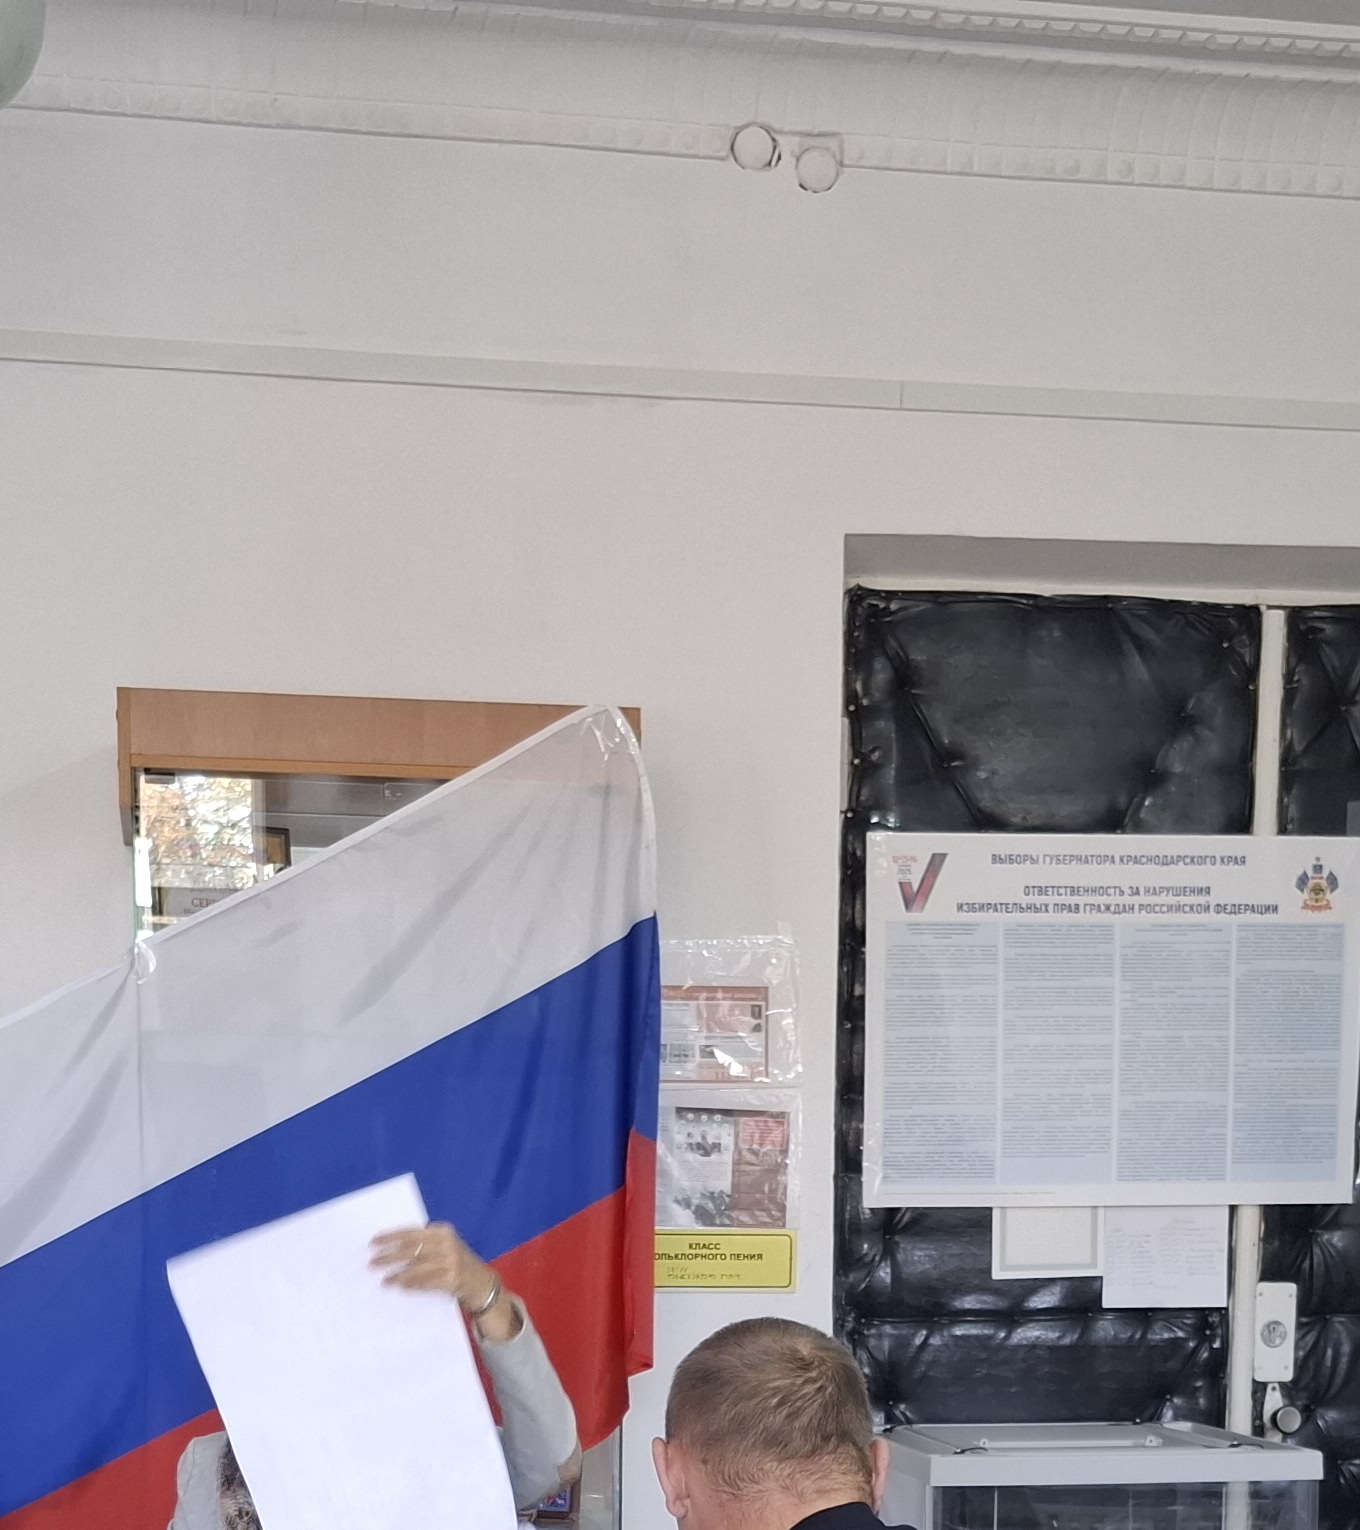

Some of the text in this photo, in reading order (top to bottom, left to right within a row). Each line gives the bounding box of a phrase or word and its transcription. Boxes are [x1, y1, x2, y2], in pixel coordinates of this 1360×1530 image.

[991, 854, 1246, 867] ВЫБОРЫ ГУБЕРНАТОРА КРАСНОДАРСКОГО КРАЯ
[1023, 885, 1212, 897] ОТВЕТСТВЕННОСТЬ ЗА НАРУШЕНИЯ
[956, 901, 1279, 916] ИЗБИРАТЕЛЬНЫХ ПРАВ ГРАЖДАН РОССИЙСКОЙ ФЕДЕРАЦИИ
[688, 1242, 721, 1250] КЛАСС
[655, 1252, 763, 1261] ОЛЬКЛОРНОГО ПЕНИЯ
